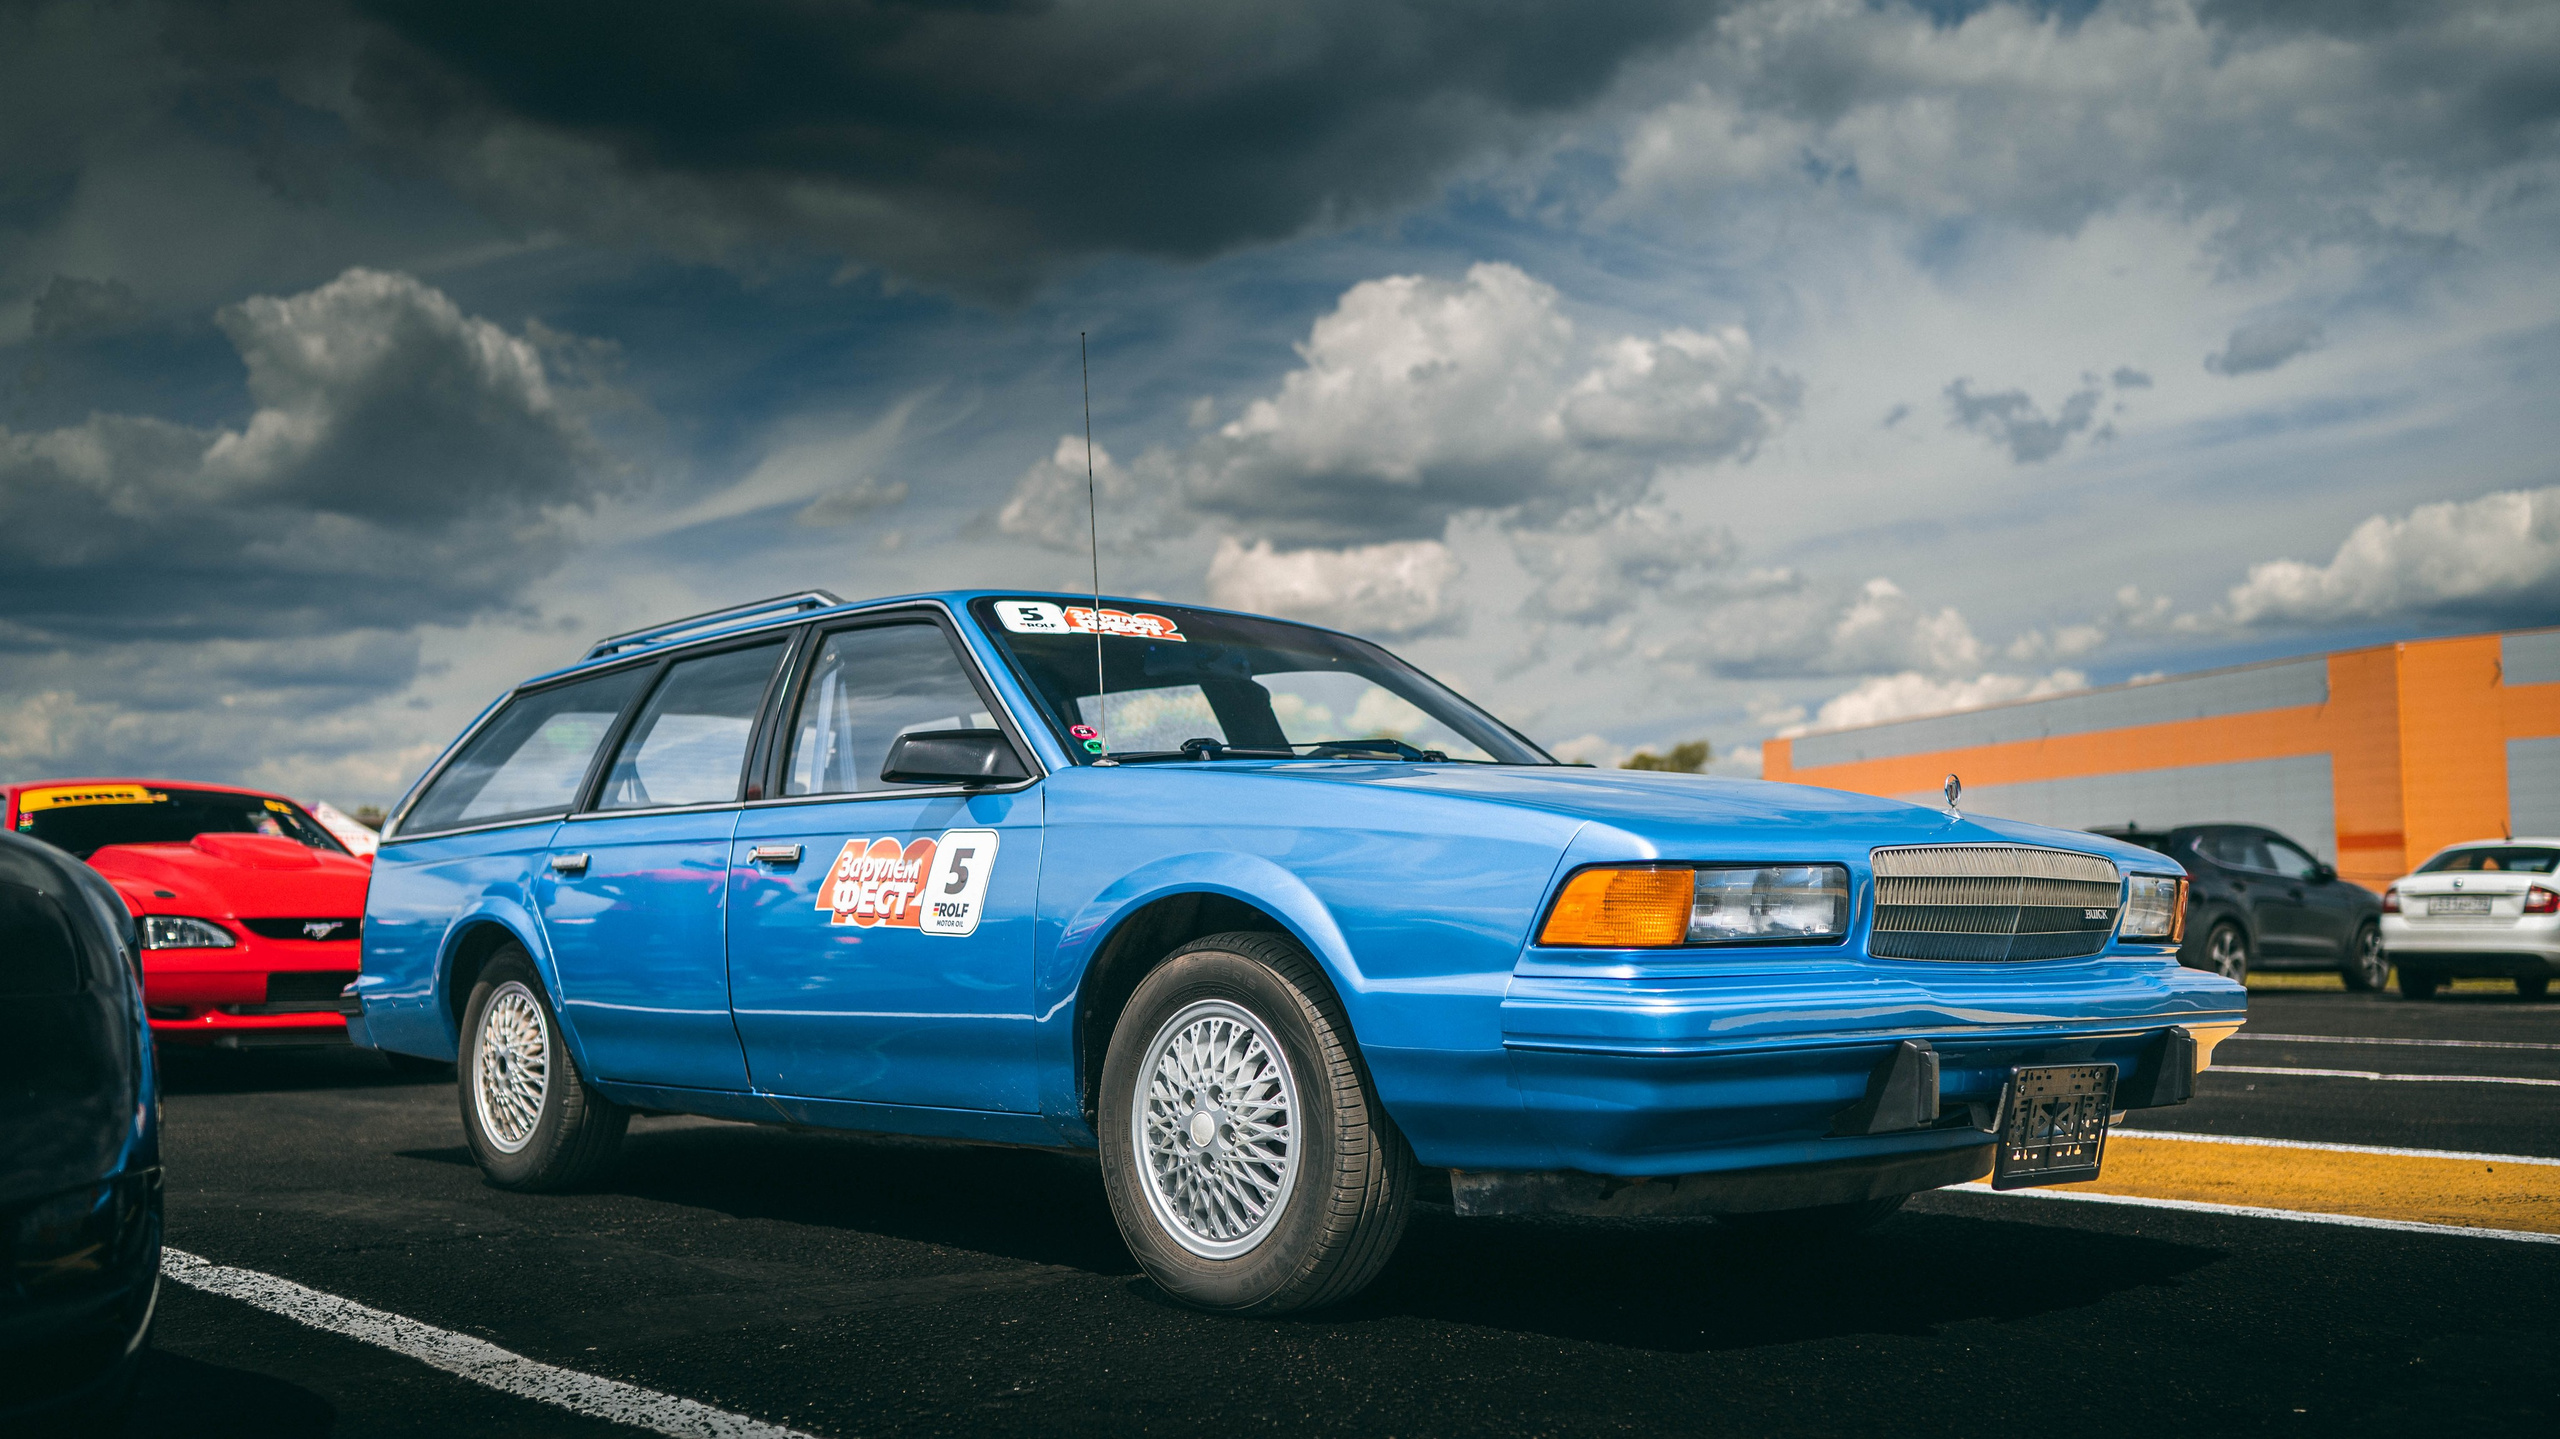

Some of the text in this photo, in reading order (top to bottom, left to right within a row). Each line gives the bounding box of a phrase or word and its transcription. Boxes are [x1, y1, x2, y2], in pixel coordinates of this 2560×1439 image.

[1018, 607, 1044, 621] 5
[944, 848, 976, 895] 5
[832, 879, 917, 919] ФЕСТ
[938, 902, 970, 918] ROLF
[2084, 909, 2109, 920] BUICK
[936, 919, 964, 928] MOTOR OIL
